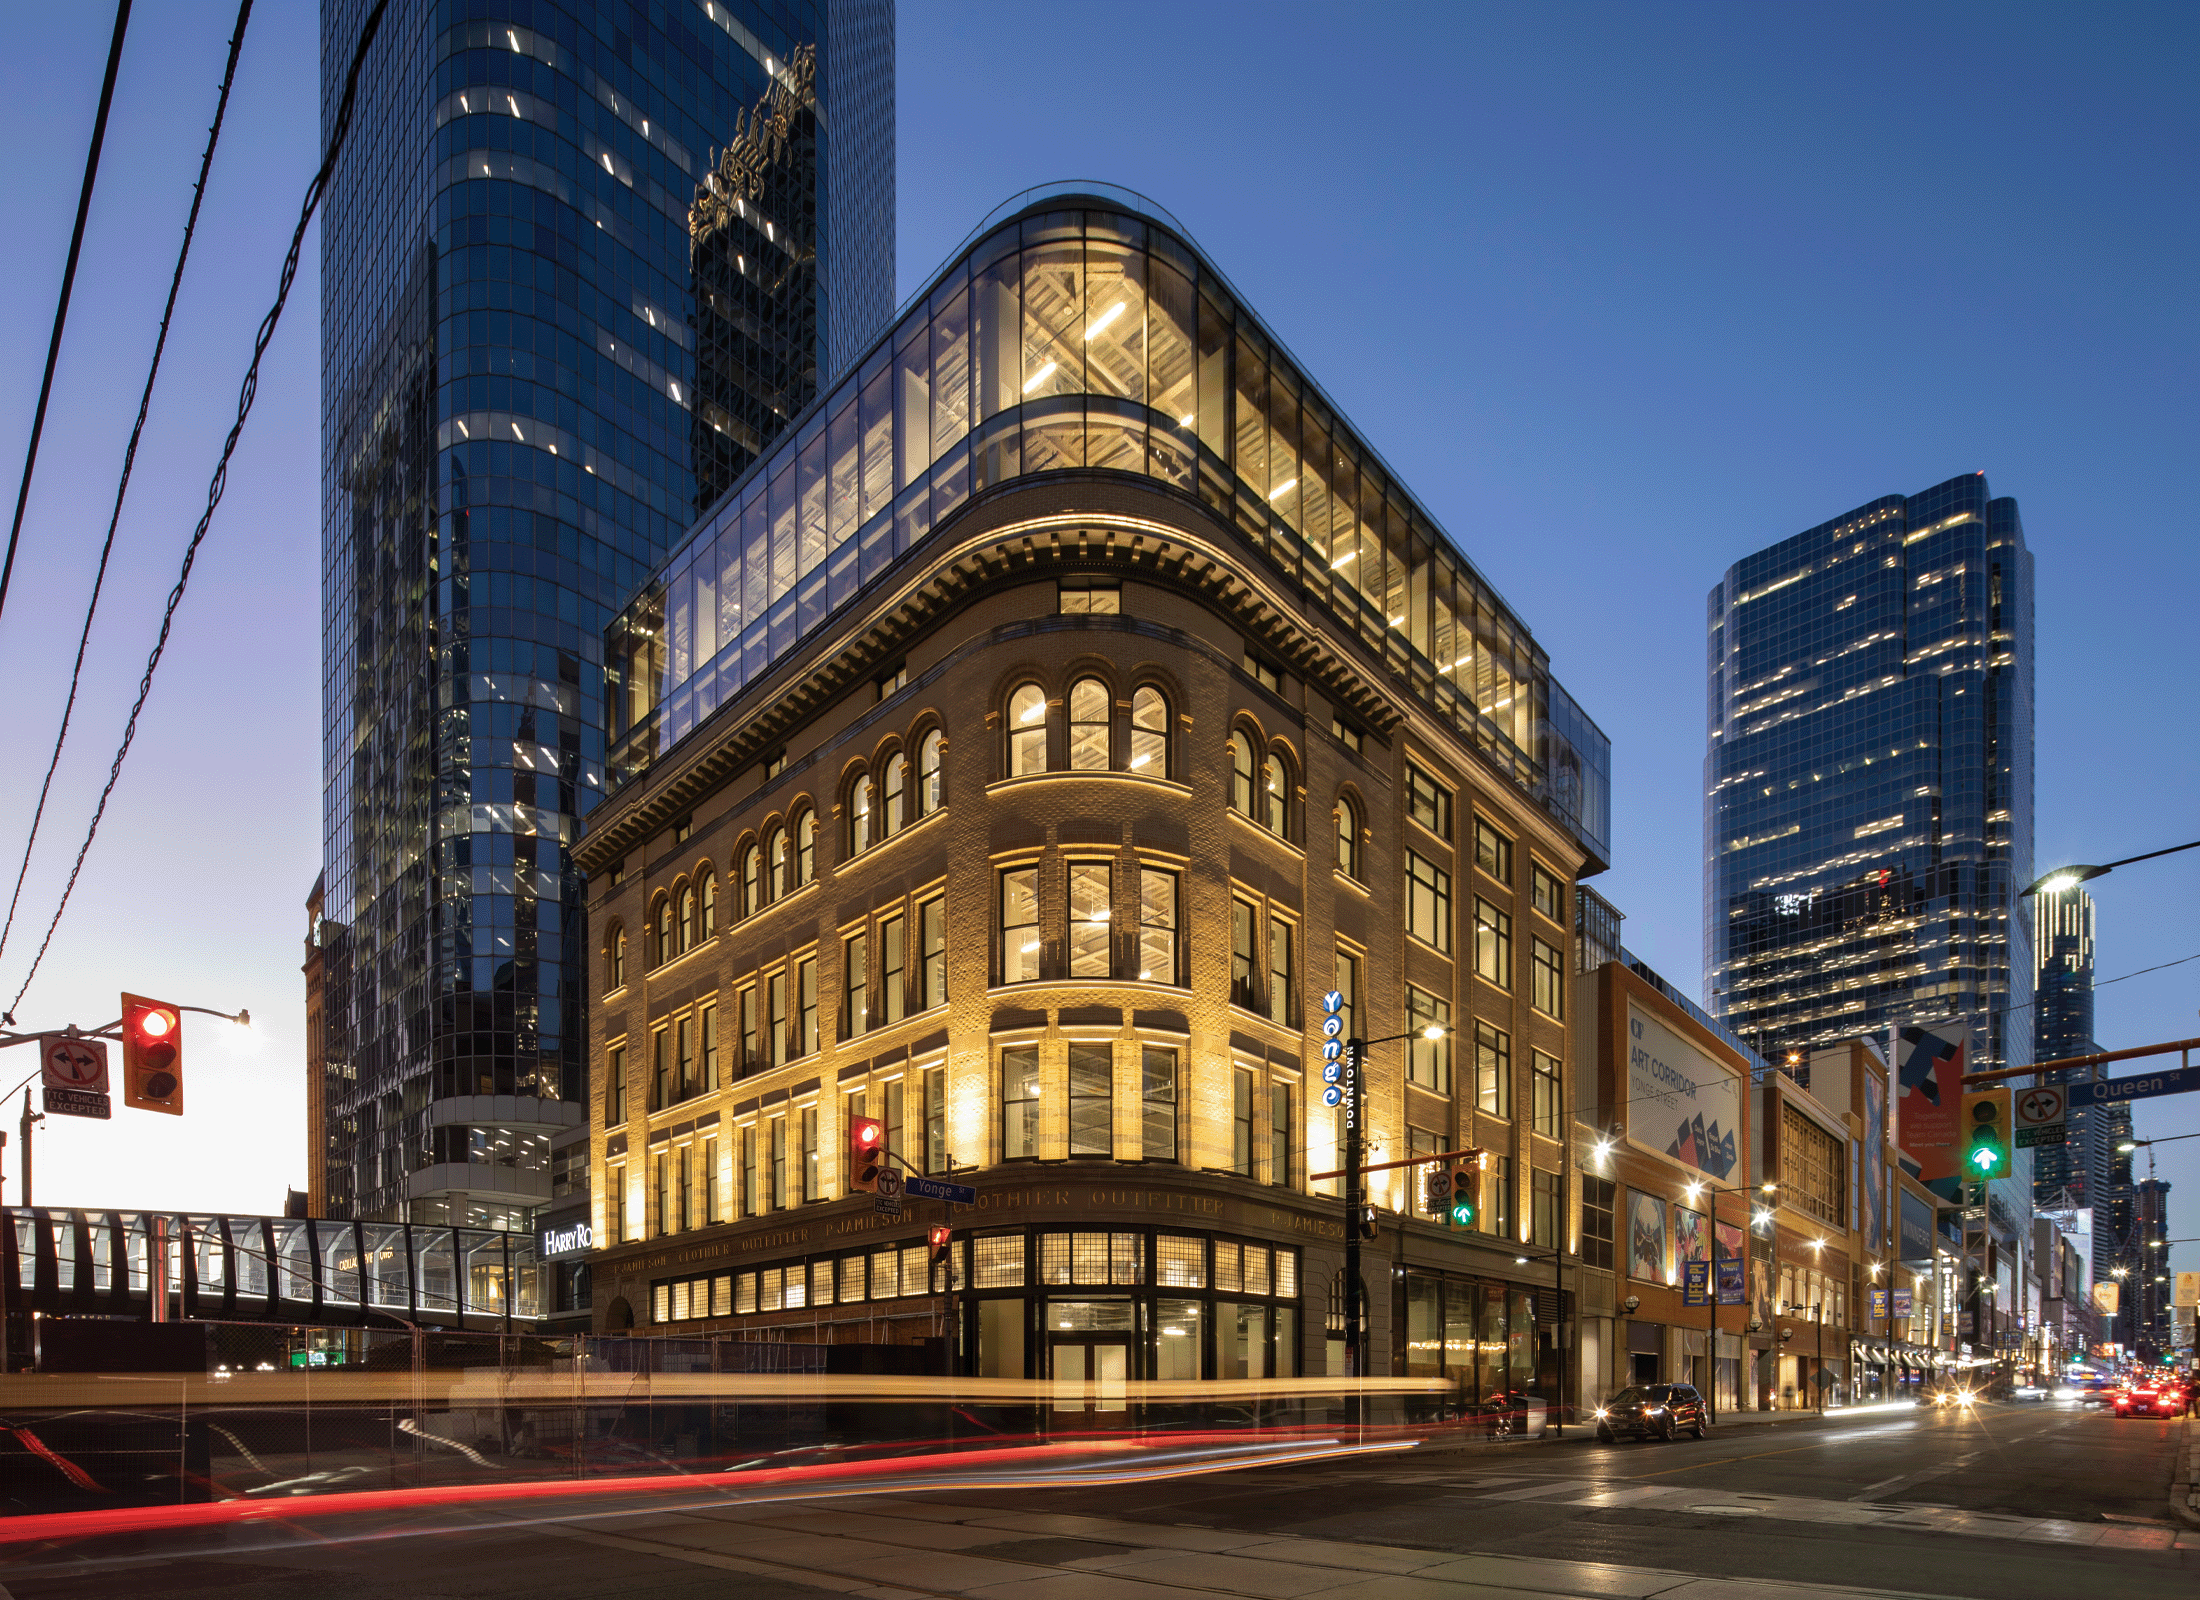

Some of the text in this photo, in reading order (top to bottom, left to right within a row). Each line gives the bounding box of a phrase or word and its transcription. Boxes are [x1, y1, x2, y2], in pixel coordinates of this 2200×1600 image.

[1630, 1018, 1644, 1040] CF
[1322, 990, 1341, 1107] Yonge
[1631, 1045, 1697, 1100] ART CORRIDOR
[1346, 1046, 1354, 1129] DOWNTOWN
[1630, 1074, 1679, 1110] YONGE STREET
[2093, 1072, 2181, 1099] Queen St
[46, 1090, 109, 1106] TTC VEHICLES
[49, 1101, 106, 1116] EXCEPTED
[2019, 1134, 2063, 1146] EXCEPTED
[919, 1180, 952, 1199] Yonge
[953, 1190, 1225, 1215] CLOTHIER OUTFITTER
[1284, 1215, 1344, 1238] JAMIESO
[1689, 1264, 1704, 1274] PI
[1688, 1282, 1704, 1303] LIFE
[1874, 1291, 1885, 1299] PI
[1873, 1303, 1885, 1317] LIFE
